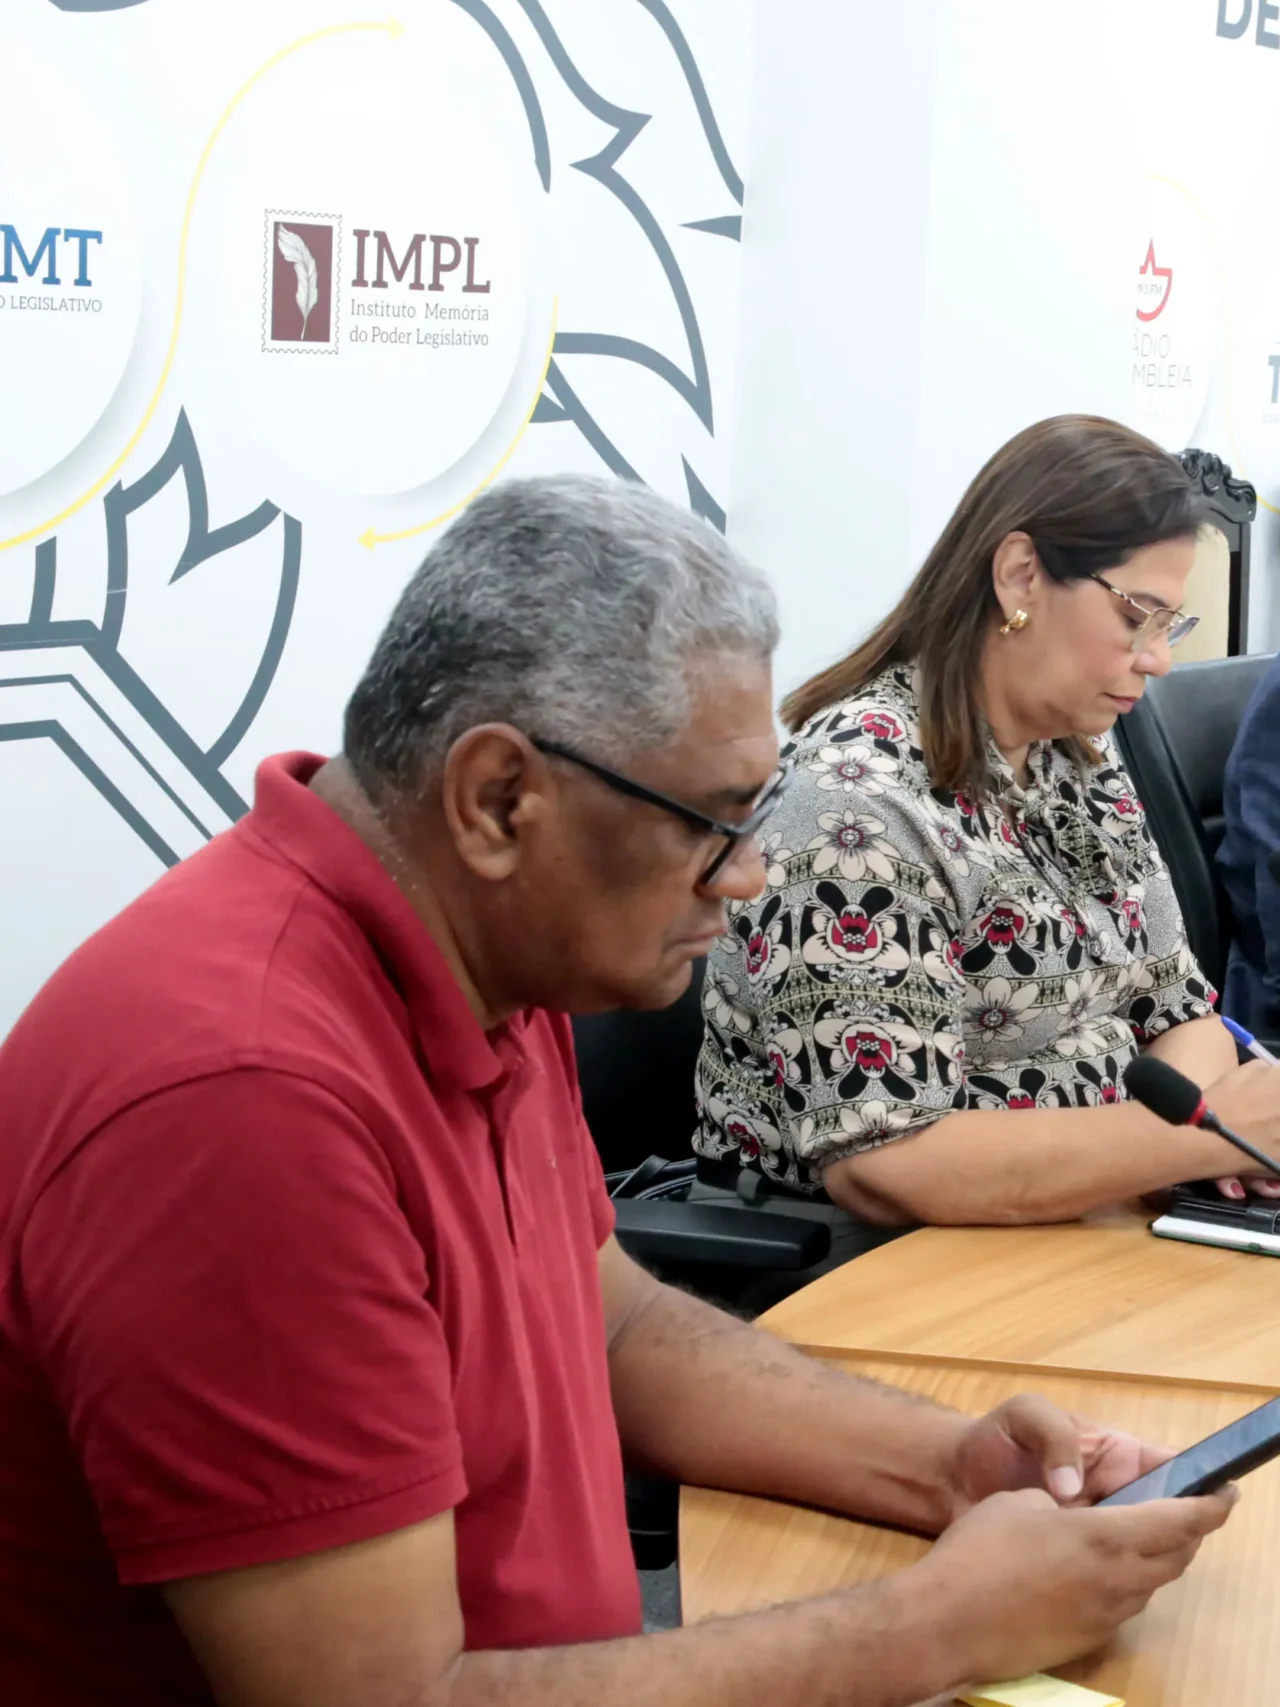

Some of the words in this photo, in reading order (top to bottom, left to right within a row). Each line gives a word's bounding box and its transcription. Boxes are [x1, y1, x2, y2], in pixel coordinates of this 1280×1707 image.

[351, 229, 491, 293] IMPL
[10, 295, 103, 313] LEGISLATIVO
[350, 299, 416, 318] Instituto
[424, 302, 490, 321] Memória
[349, 325, 368, 343] do
[371, 325, 412, 345] Poder
[416, 328, 489, 349] Legislativo
